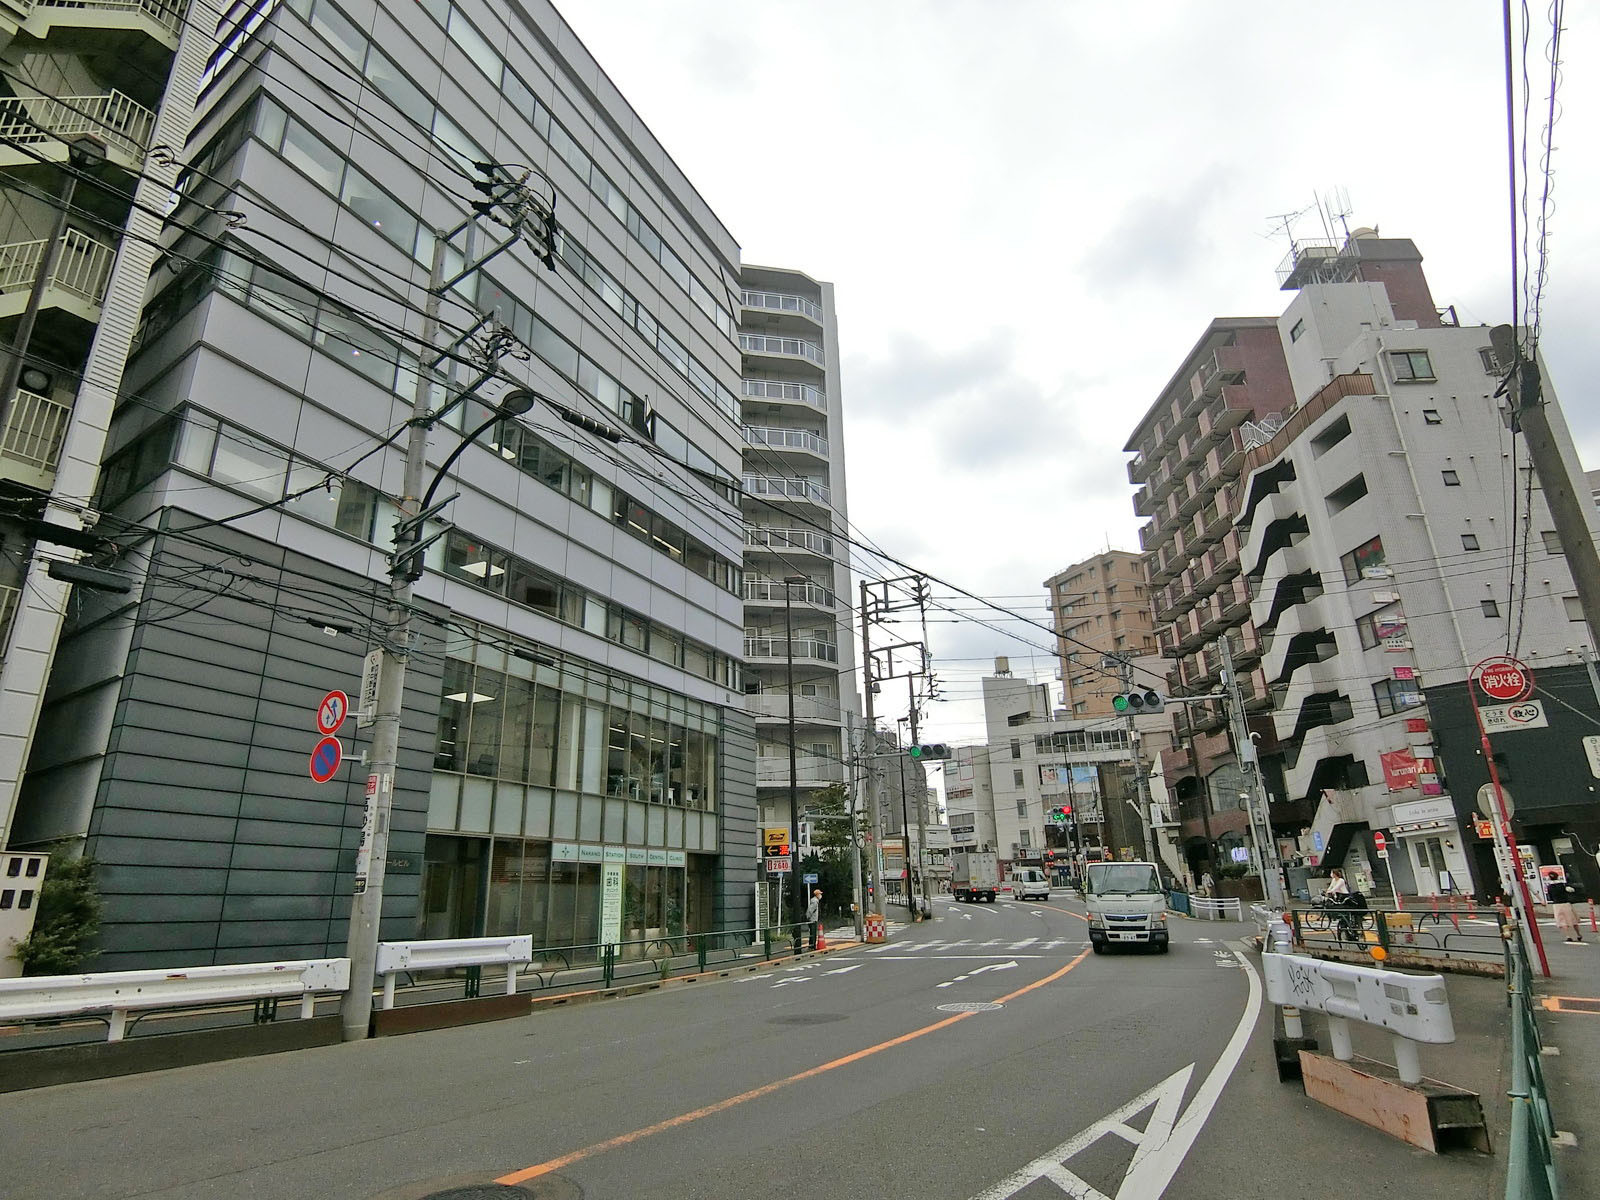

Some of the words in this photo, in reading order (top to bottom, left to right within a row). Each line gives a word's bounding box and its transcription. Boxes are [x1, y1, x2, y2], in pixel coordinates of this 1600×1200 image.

[1483, 672, 1522, 689] 消火栓
[581, 849, 601, 857] NAKANO
